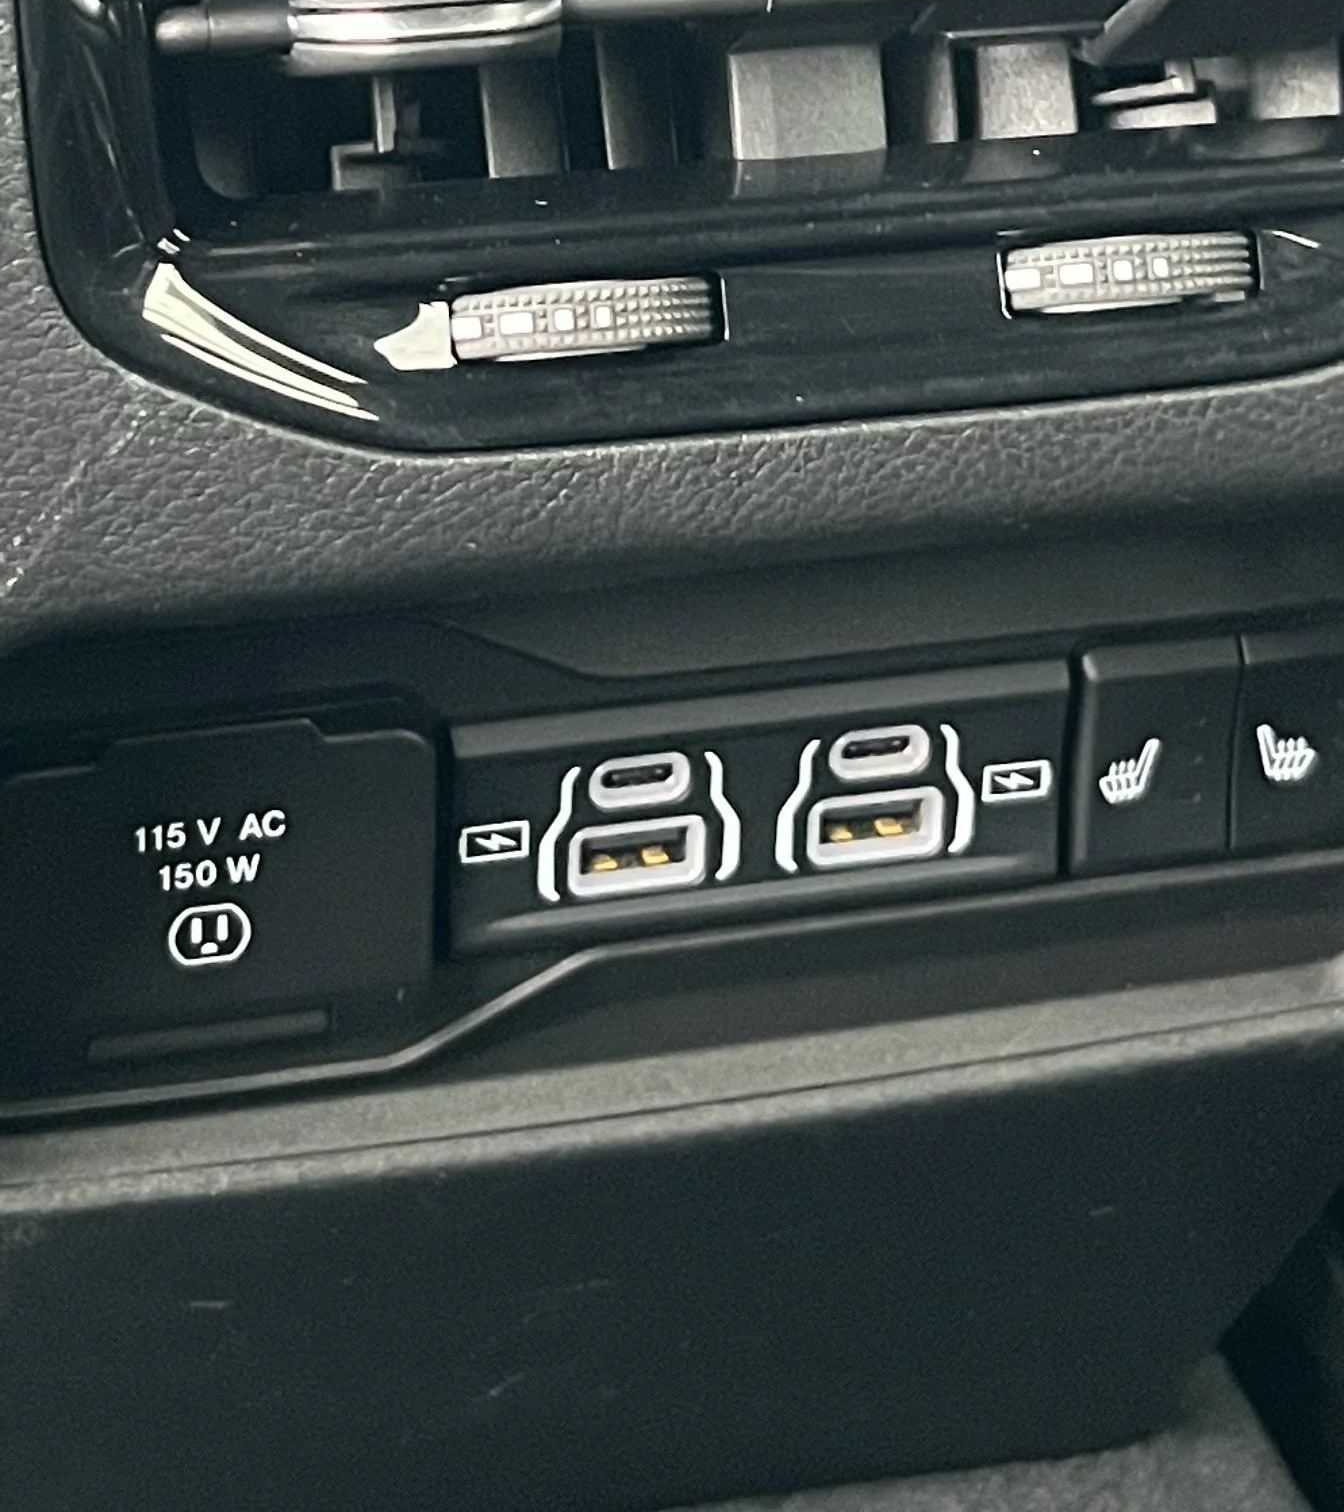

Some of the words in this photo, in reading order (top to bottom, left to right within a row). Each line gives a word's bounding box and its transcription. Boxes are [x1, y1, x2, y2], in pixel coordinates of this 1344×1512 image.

[134, 821, 187, 853] 115
[196, 816, 222, 846] V
[238, 809, 287, 841] AC
[158, 859, 217, 892] 150
[225, 853, 261, 884] W
